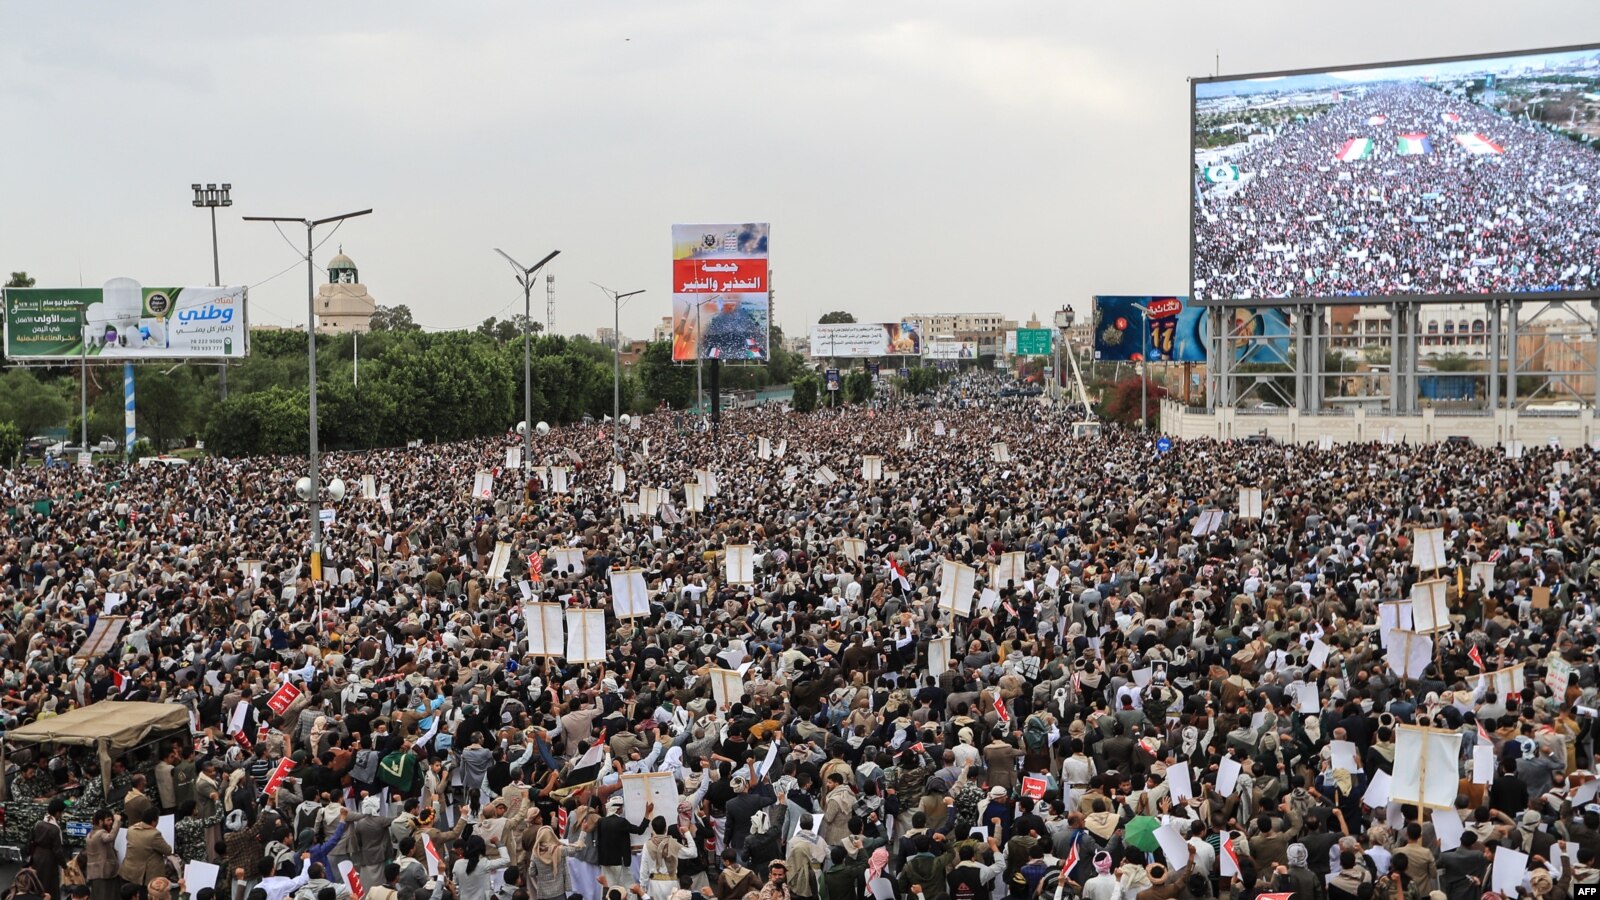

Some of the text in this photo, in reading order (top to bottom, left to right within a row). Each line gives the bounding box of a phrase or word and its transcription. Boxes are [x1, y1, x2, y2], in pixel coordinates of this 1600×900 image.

[701, 260, 738, 274] جمعة
[681, 277, 760, 292] التحذير والنفير
[34, 314, 60, 324] الأولى
[178, 304, 234, 325] وطني
